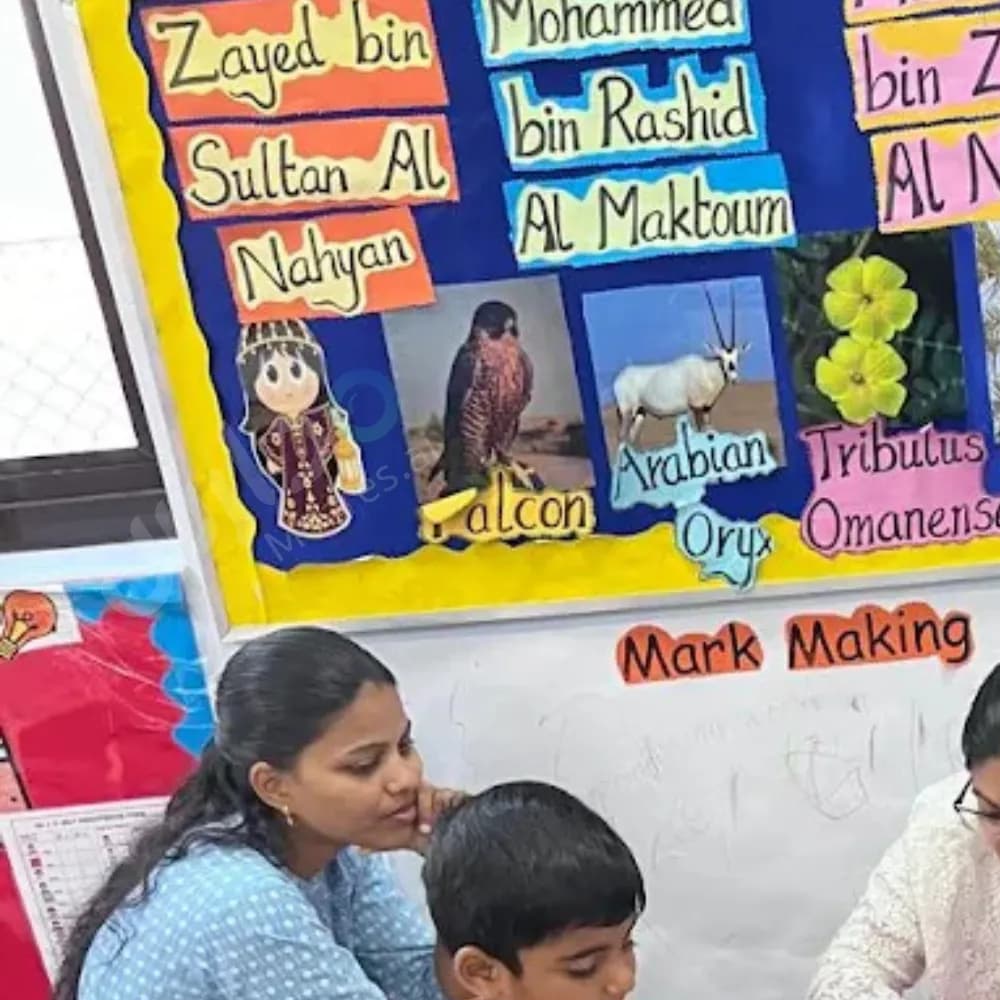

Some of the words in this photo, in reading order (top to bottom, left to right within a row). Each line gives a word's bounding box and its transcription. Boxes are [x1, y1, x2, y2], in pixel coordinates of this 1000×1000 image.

[157, 4, 325, 108] Zayed
[353, 0, 430, 65] bin
[861, 33, 941, 112] bin
[508, 82, 581, 157] bin
[597, 65, 753, 148] Rashid
[190, 138, 348, 206] Sultan
[380, 128, 446, 190] Al
[883, 138, 945, 222] Al
[520, 191, 574, 254] Al
[598, 175, 788, 250] Maktoum
[237, 228, 409, 311] Nahyan
[615, 417, 768, 498] Arabian
[433, 474, 586, 538] alcon
[682, 511, 774, 588] Oryx
[623, 622, 760, 679] Mark
[788, 611, 972, 670] Making
